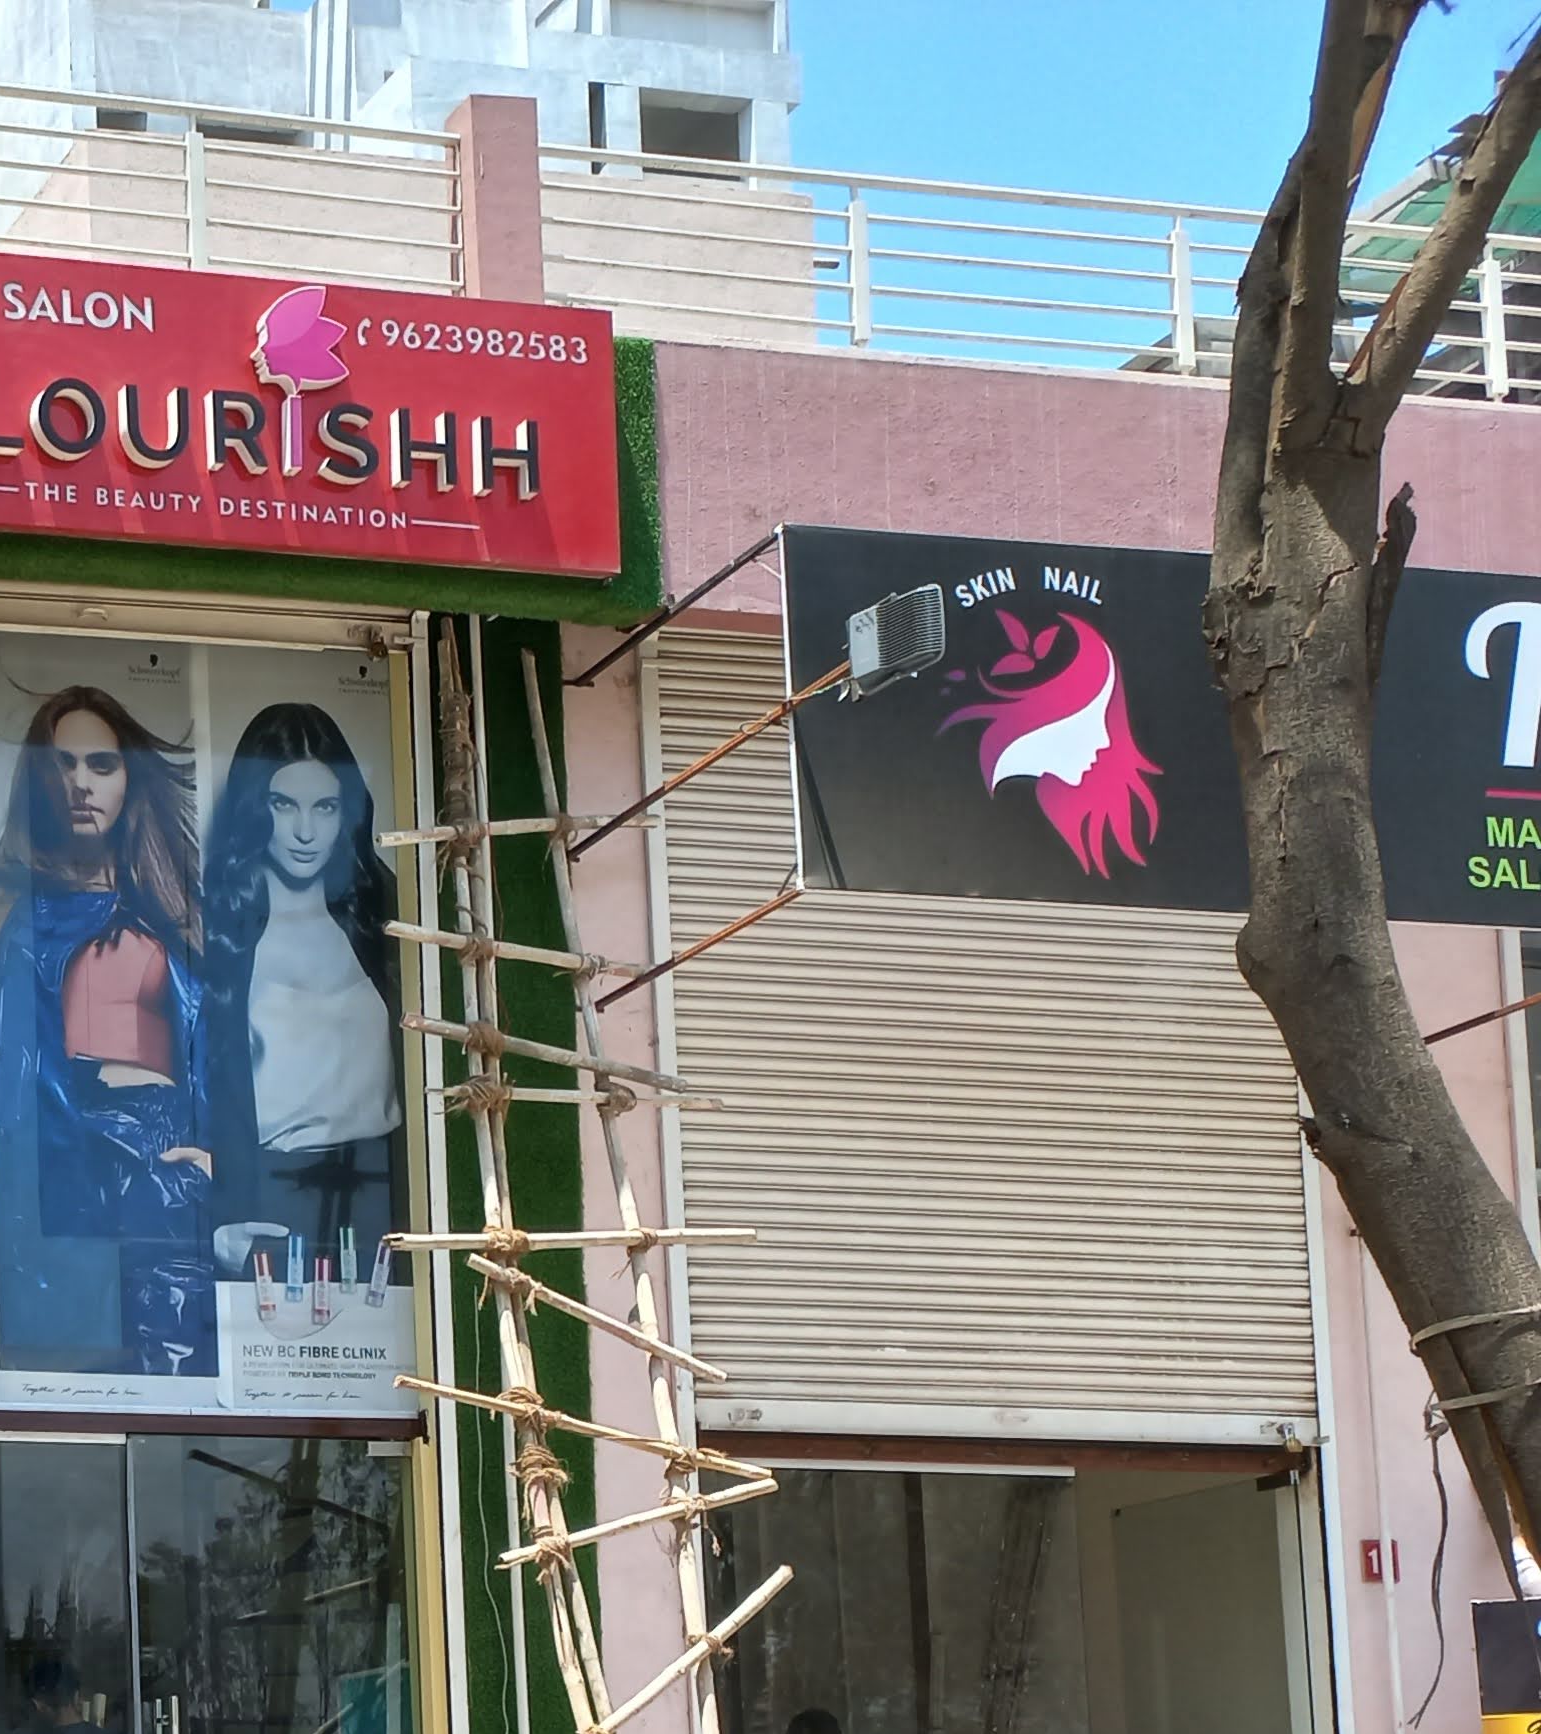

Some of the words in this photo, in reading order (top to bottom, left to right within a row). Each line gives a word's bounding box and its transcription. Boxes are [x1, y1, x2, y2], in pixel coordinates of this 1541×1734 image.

[3, 282, 155, 333] SALON
[381, 318, 588, 365] 9623982583
[25, 482, 77, 504] THE
[96, 488, 201, 513] BEAUTY
[219, 496, 407, 529] DESTINATION
[955, 567, 1016, 607] SKIN
[1044, 566, 1102, 605] NAIL
[243, 1344, 274, 1358] NEW
[277, 1345, 296, 1358] BC
[299, 1345, 340, 1359] FIBRE
[342, 1346, 387, 1360] CLINIX
